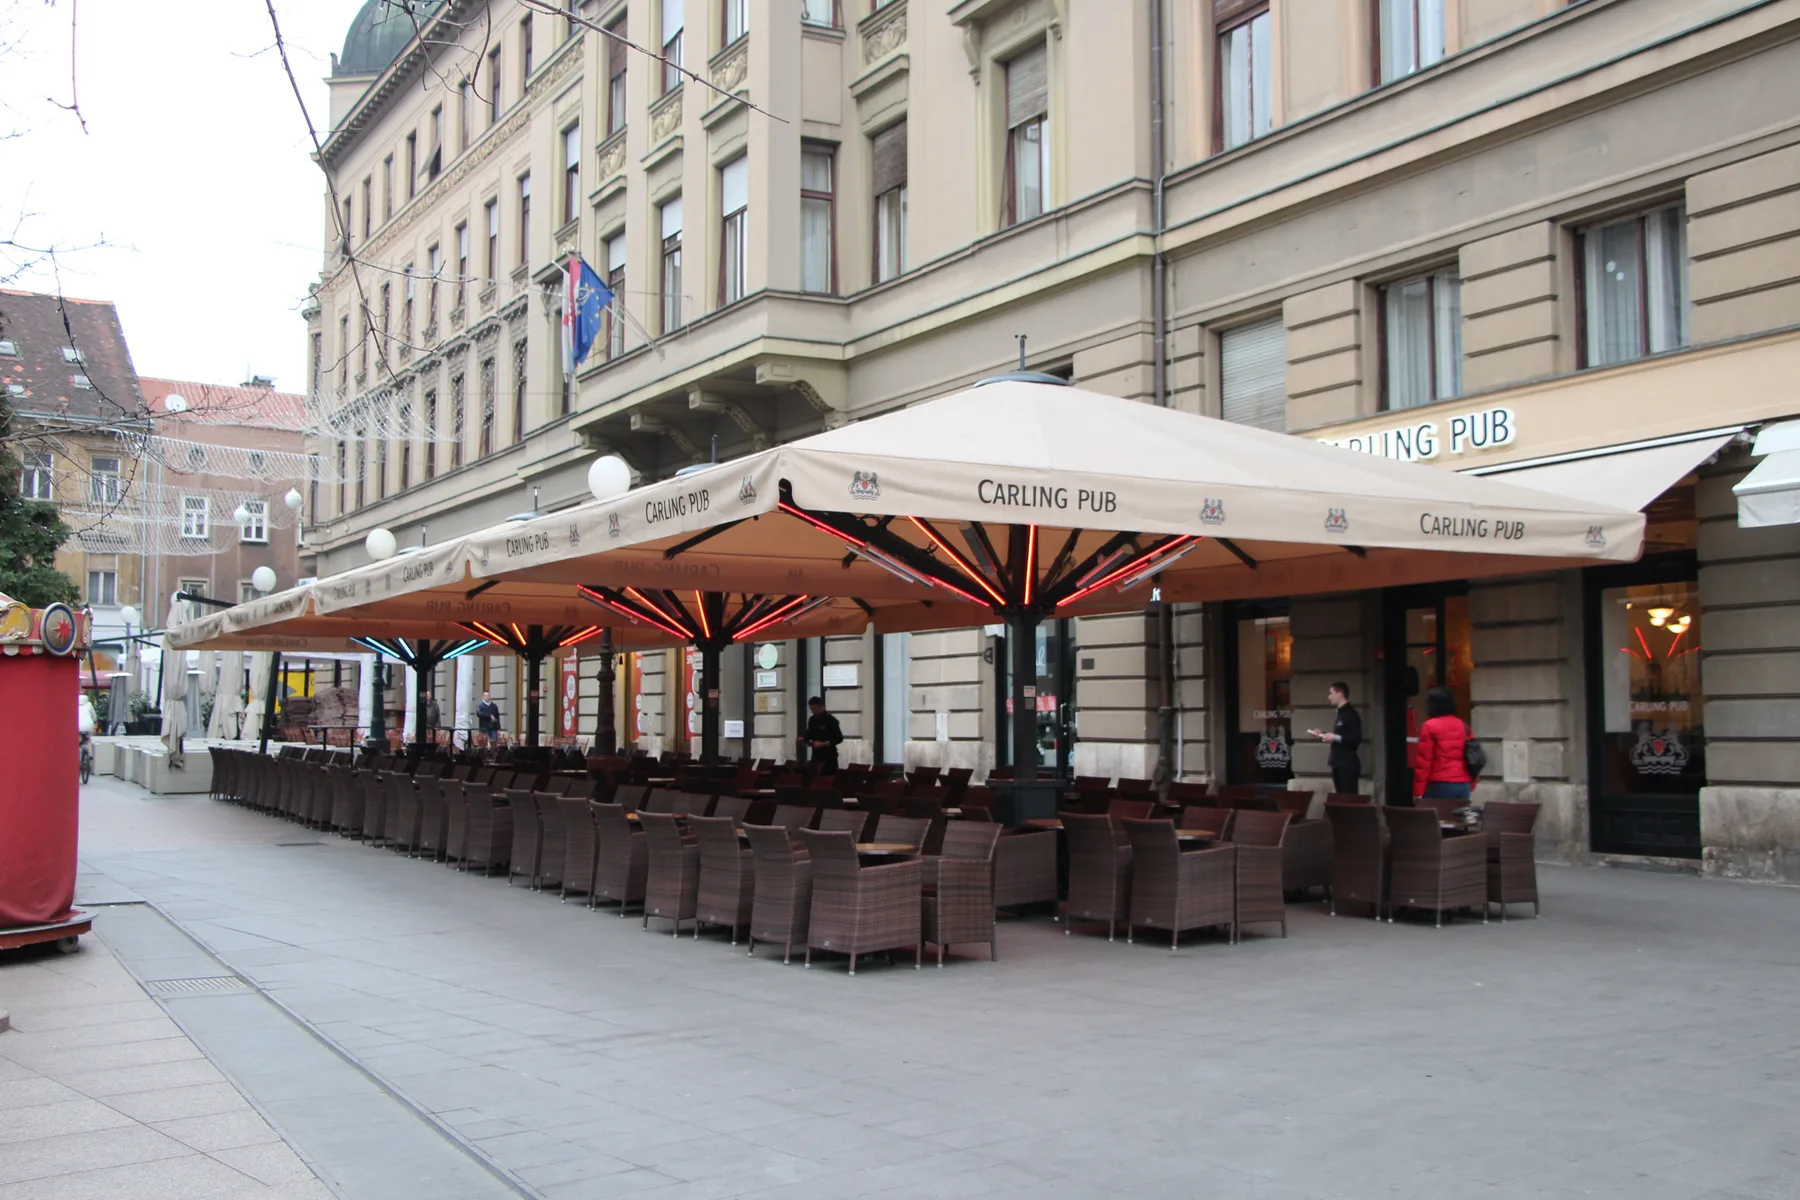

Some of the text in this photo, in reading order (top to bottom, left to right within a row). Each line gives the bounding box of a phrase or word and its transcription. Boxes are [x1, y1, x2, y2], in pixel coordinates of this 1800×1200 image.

[1451, 409, 1509, 452] PUB
[645, 488, 710, 524] CARLING PUB
[977, 478, 1117, 513] CARLING PUB
[1419, 512, 1525, 540] CARLING PUB
[506, 531, 550, 558] CARLING PUB
